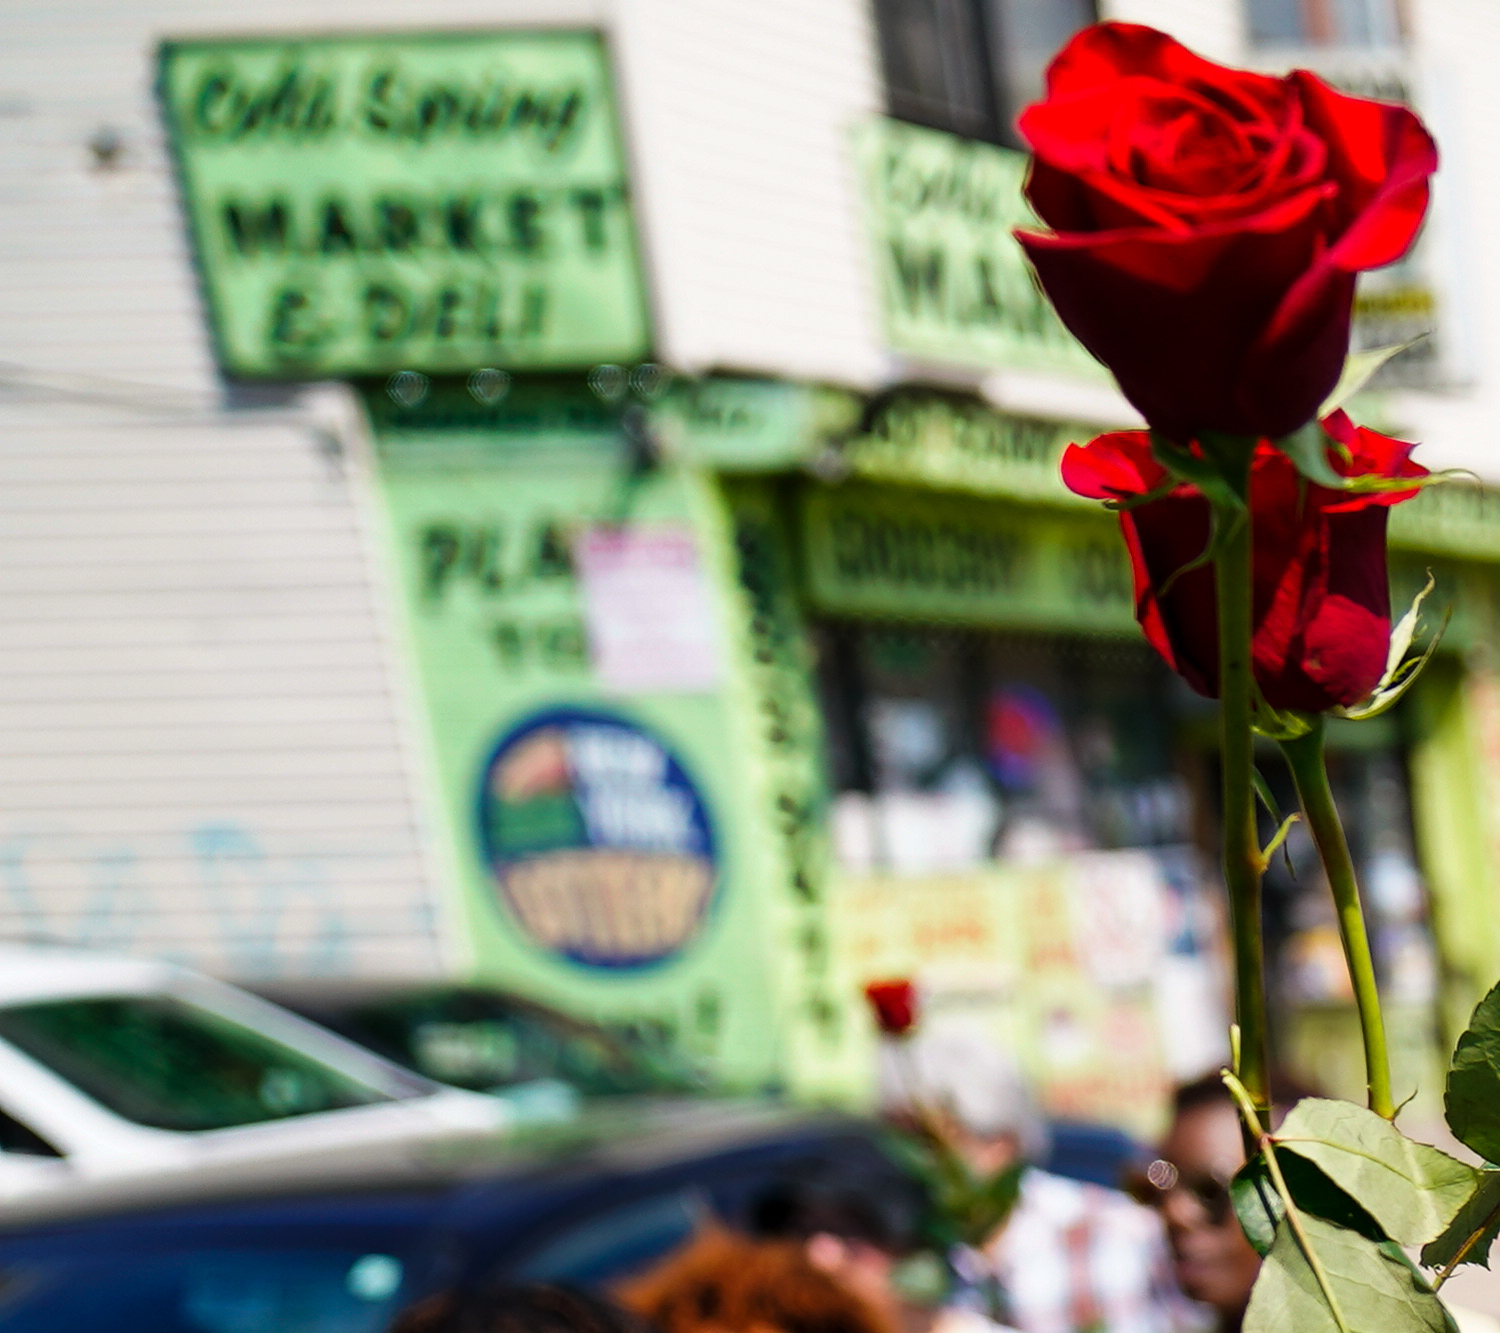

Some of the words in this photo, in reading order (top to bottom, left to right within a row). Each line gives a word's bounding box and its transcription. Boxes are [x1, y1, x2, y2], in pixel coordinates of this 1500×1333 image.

[362, 66, 586, 152] Spring
[222, 186, 626, 260] MARKET
[364, 282, 548, 342] DELI
